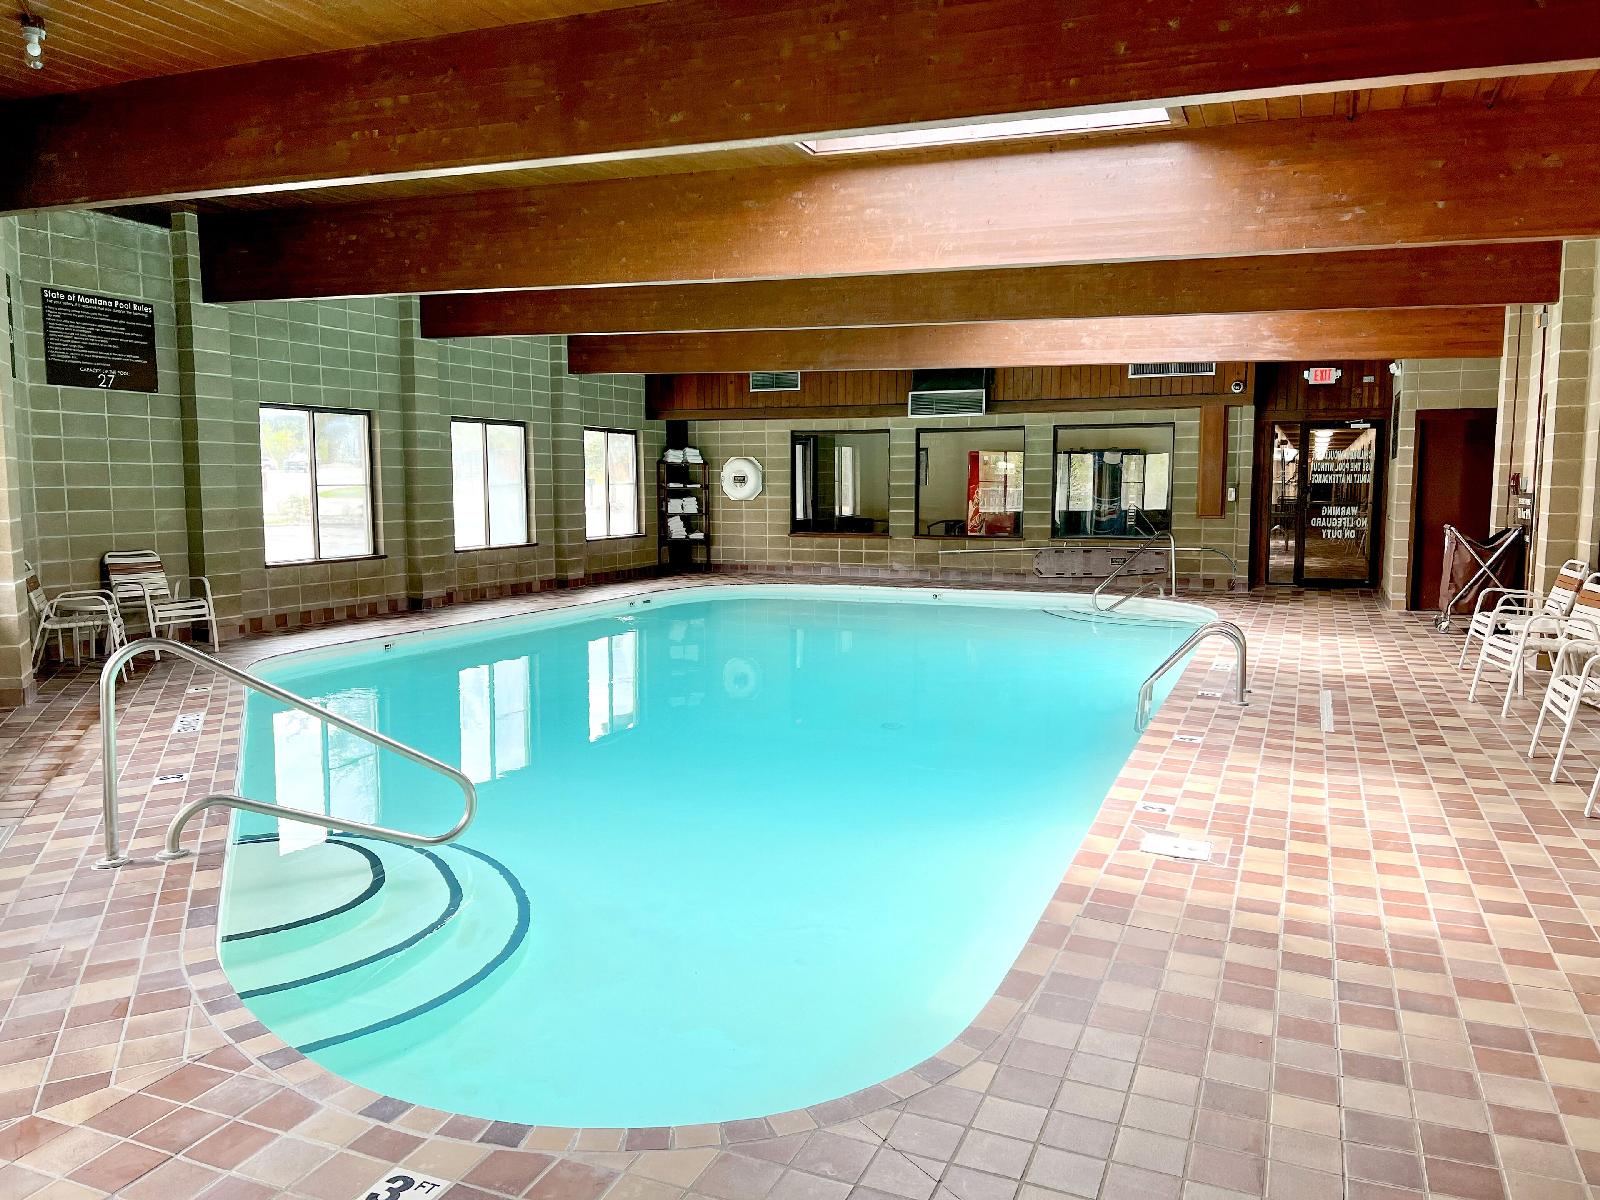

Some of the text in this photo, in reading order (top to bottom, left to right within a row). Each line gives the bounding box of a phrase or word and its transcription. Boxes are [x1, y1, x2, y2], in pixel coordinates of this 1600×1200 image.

[43, 289, 65, 300] State
[67, 293, 76, 302] of
[77, 295, 113, 307] Montana
[114, 300, 131, 310] Pool
[133, 303, 152, 314] Rules
[97, 373, 115, 388] 27
[1314, 368, 1332, 382] EXIT
[365, 1175, 441, 1200] 3 FT
